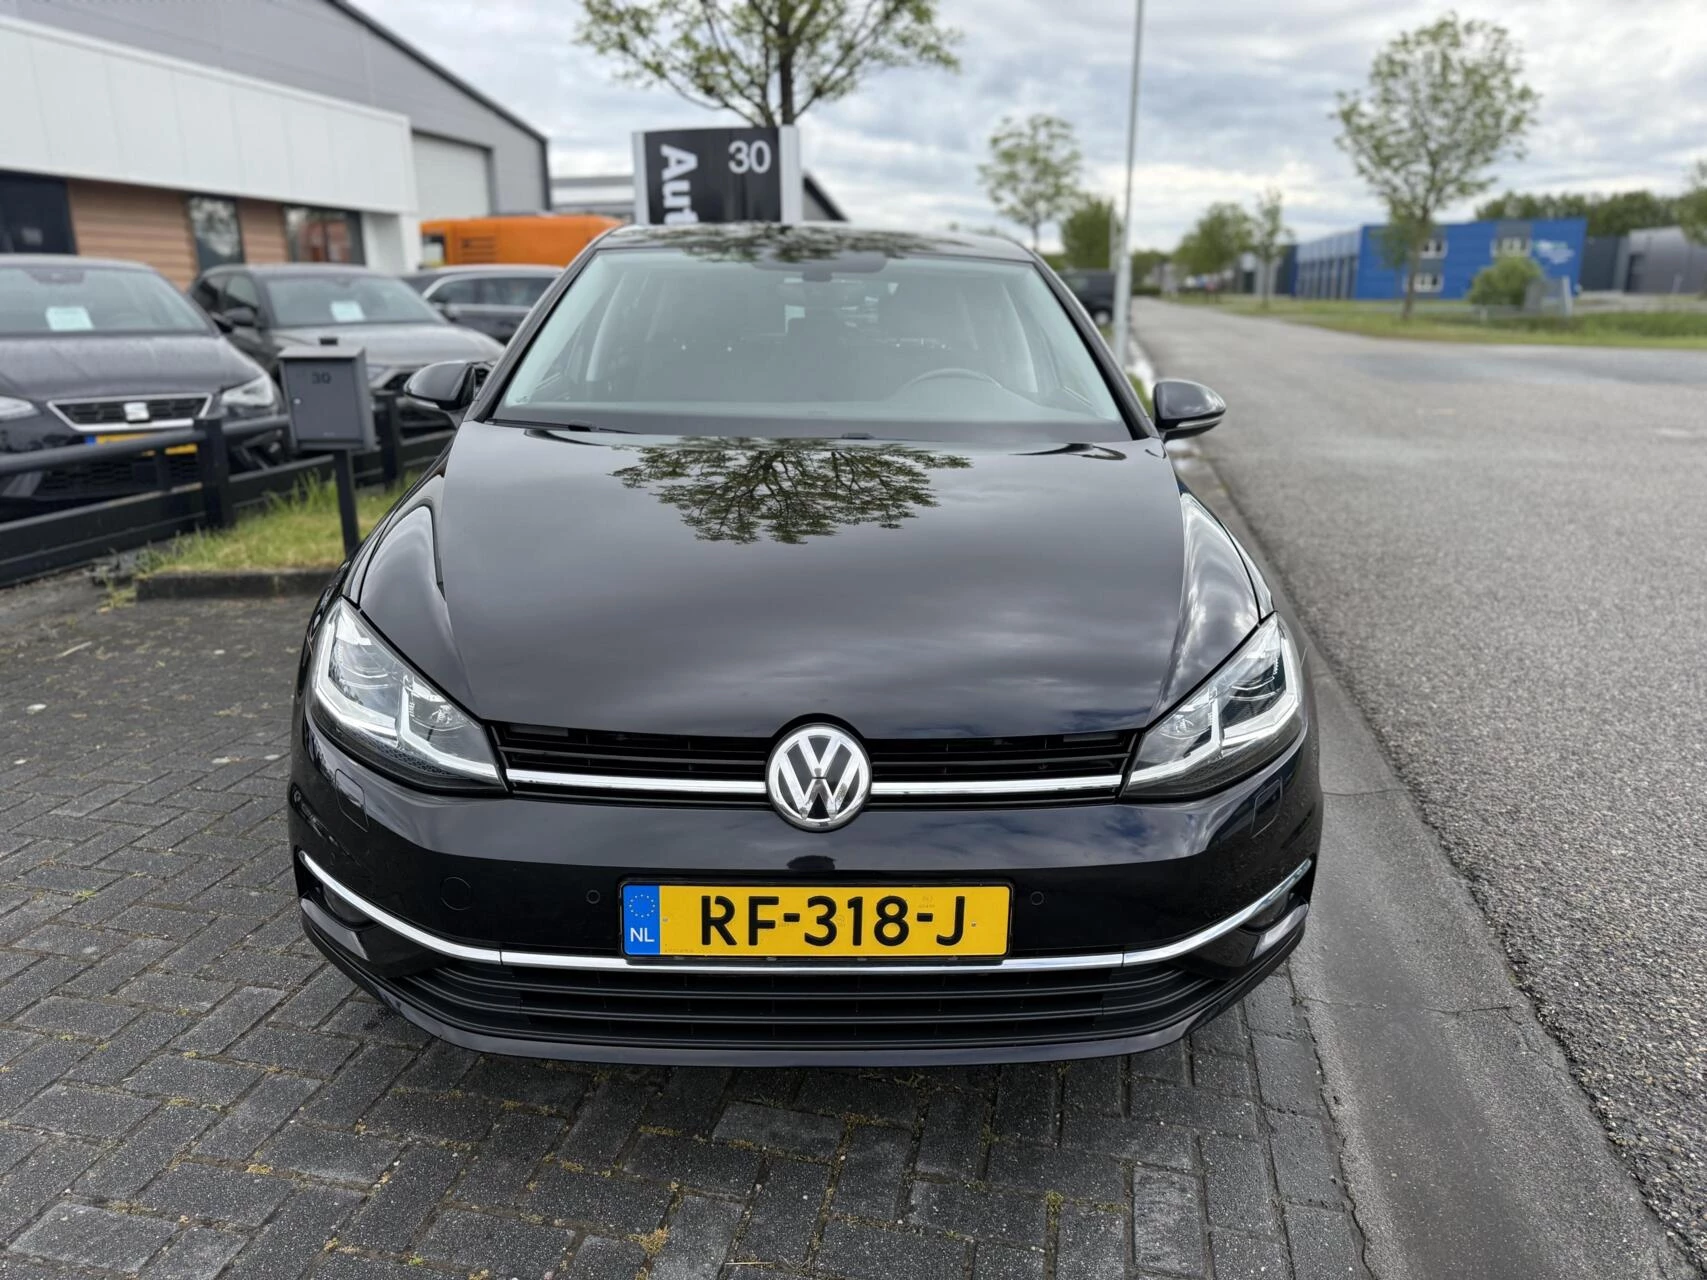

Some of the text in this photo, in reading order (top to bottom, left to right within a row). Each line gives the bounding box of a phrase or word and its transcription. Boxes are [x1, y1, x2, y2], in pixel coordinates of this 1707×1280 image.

[728, 140, 771, 173] 30
[774, 730, 864, 824] VW
[630, 927, 655, 942] NL
[701, 895, 965, 946] RF-318-J
